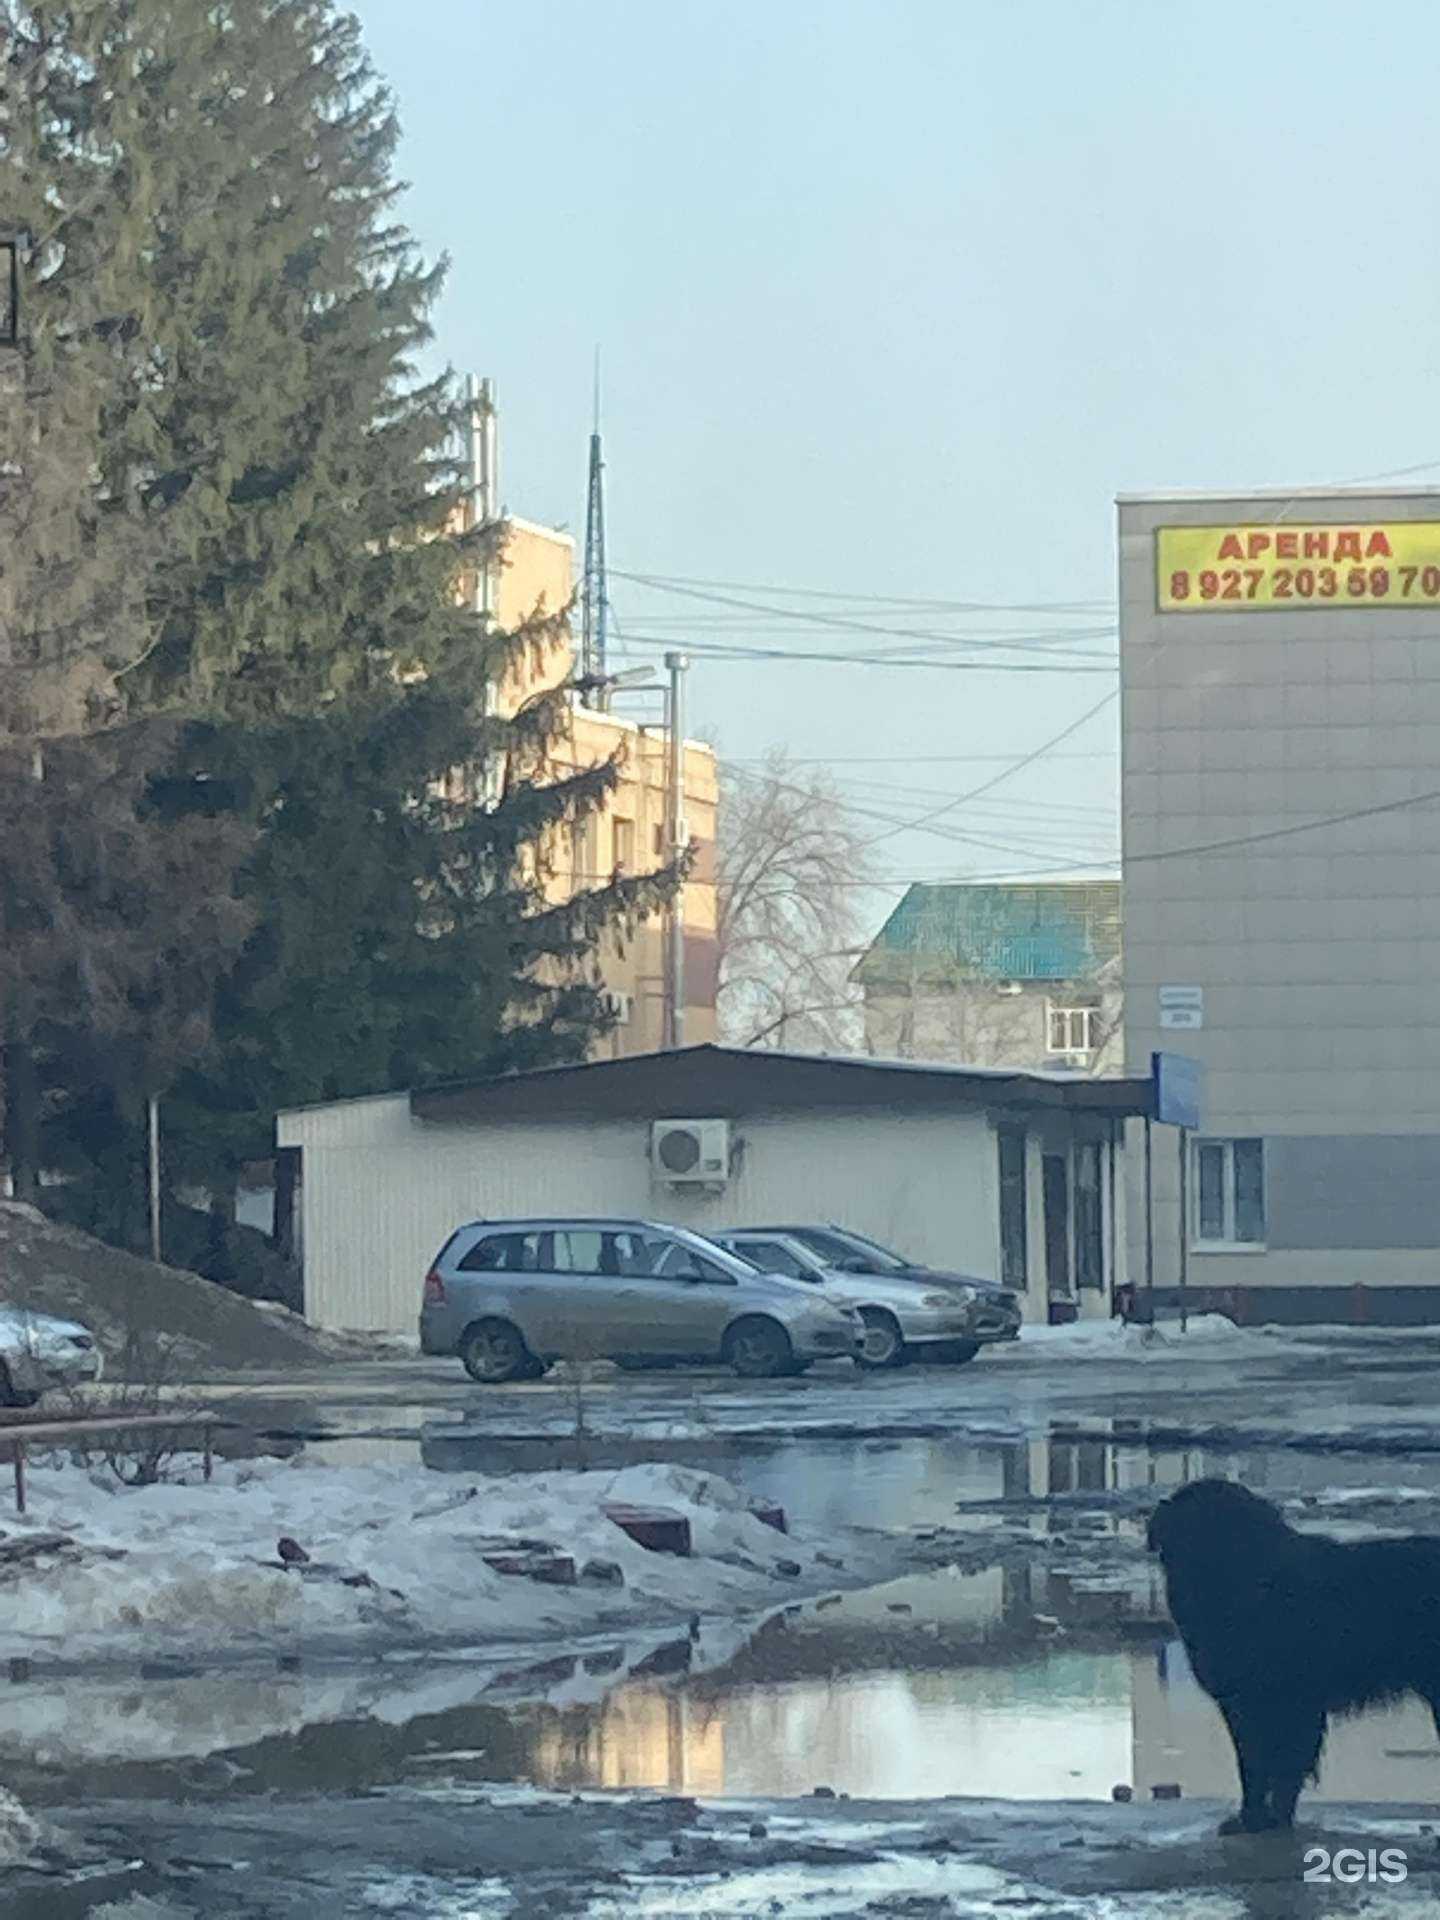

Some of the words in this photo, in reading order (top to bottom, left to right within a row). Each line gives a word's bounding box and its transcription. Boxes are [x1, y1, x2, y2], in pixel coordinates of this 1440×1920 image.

[1217, 531, 1393, 563] АРЕНДА
[1170, 570, 1191, 600] 8
[1199, 569, 1265, 599] 927
[1272, 567, 1338, 598] 203
[1398, 566, 1440, 597] 70
